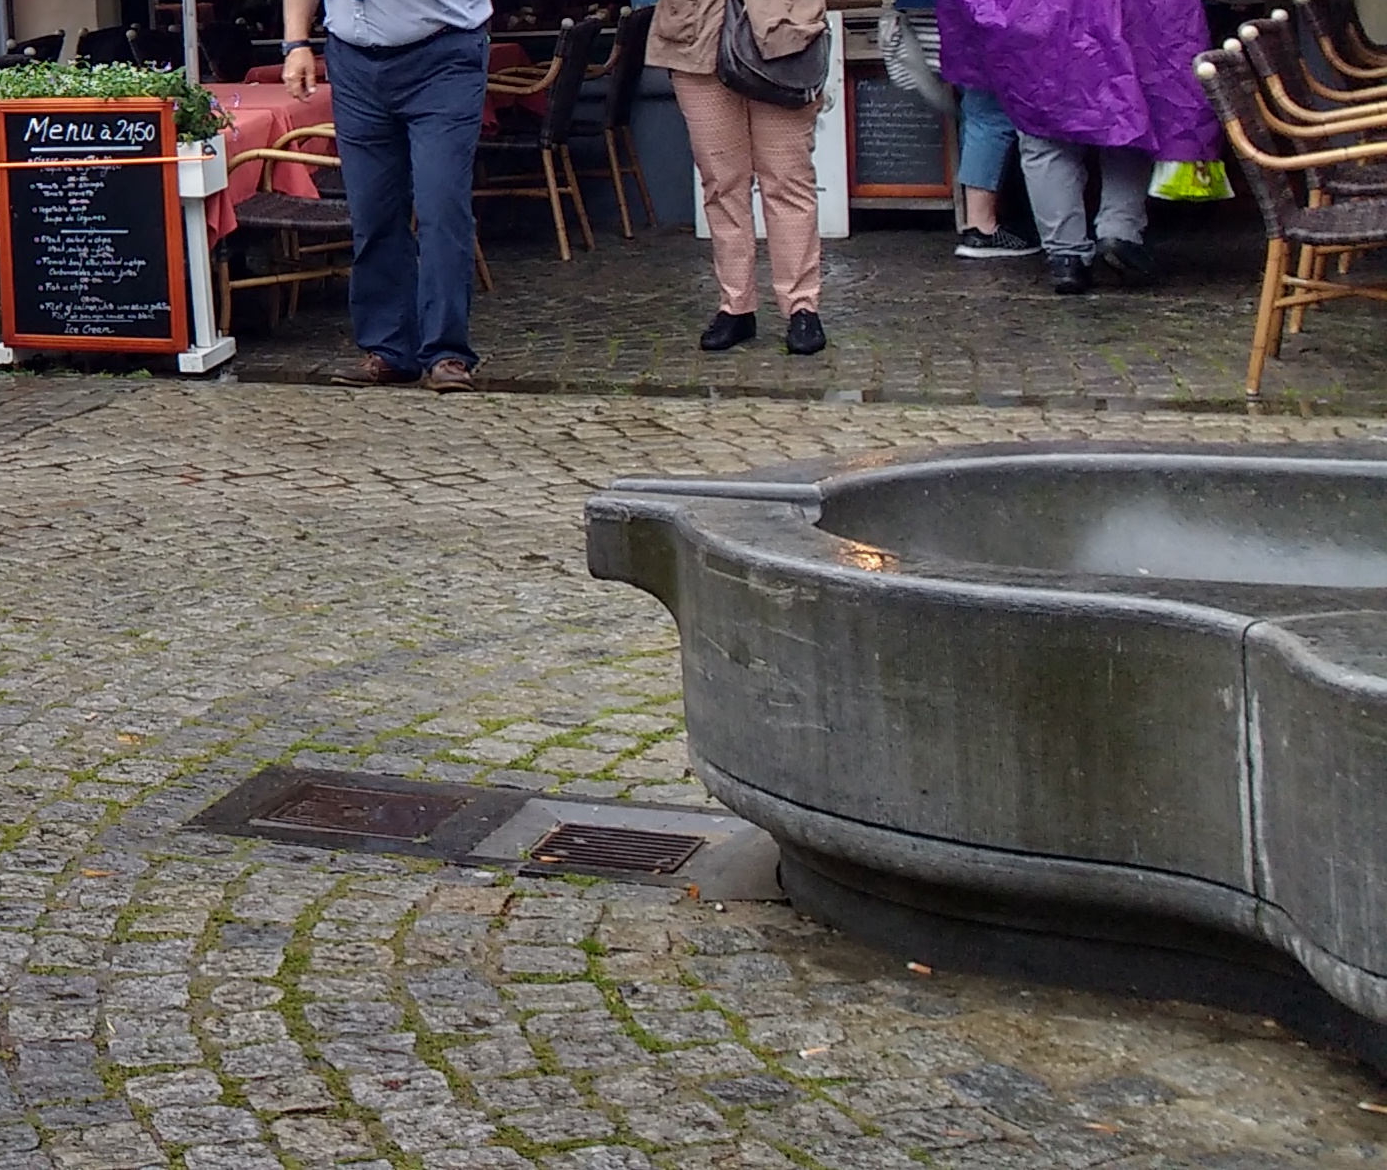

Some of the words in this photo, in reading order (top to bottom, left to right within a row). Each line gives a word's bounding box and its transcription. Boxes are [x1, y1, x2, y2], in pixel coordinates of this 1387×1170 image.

[23, 116, 95, 143] Menu
[100, 124, 113, 141] à
[114, 119, 156, 145] 21,50
[64, 323, 79, 334] Ice
